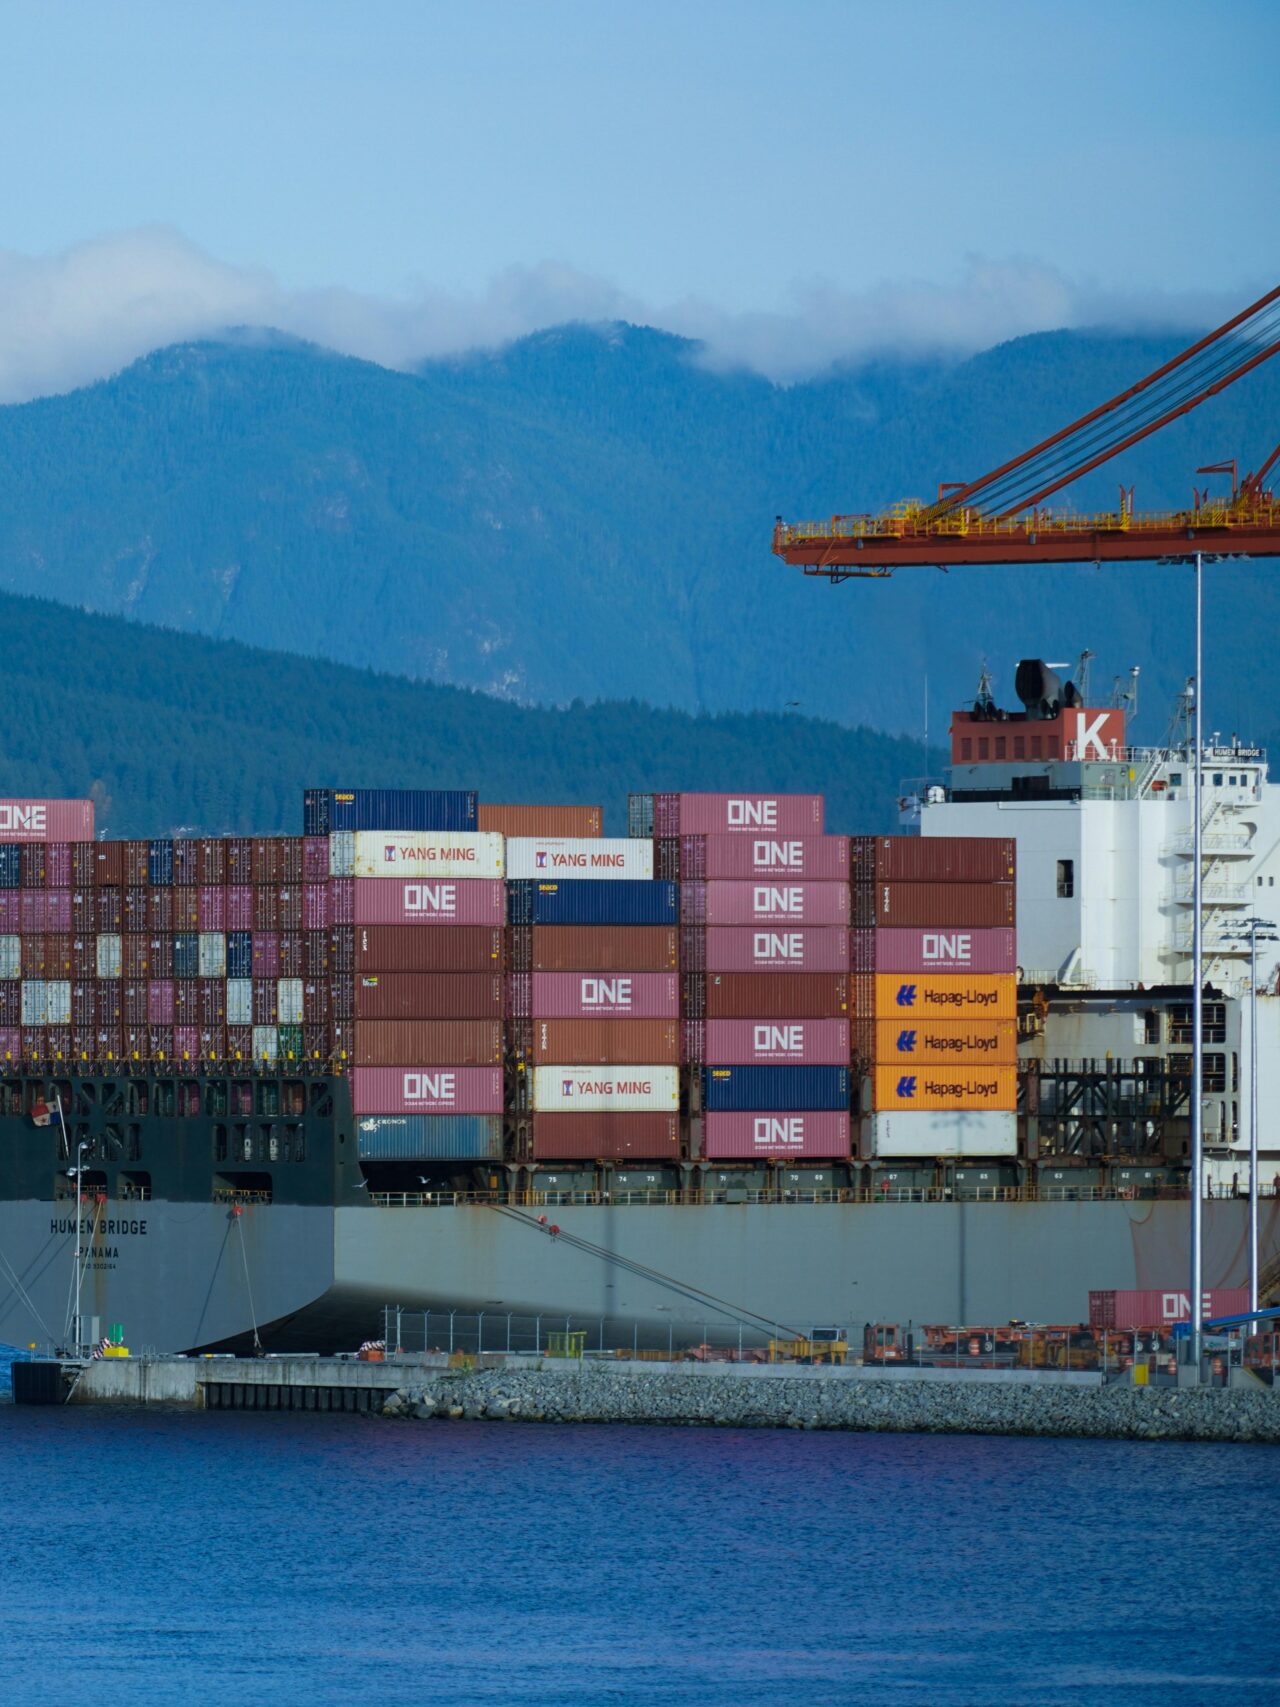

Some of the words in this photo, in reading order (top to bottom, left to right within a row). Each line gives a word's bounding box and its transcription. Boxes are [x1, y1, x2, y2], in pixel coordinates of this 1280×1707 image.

[1076, 712, 1111, 760] K
[1214, 748, 1236, 756] HUMEN
[1237, 748, 1260, 757] BRIDGE
[728, 800, 777, 825] ONE
[400, 847, 436, 861] YANG
[440, 847, 475, 861] MING
[551, 853, 587, 867] YANG
[591, 853, 625, 867] MING
[754, 841, 803, 866] ONE
[404, 885, 456, 910] ONE
[754, 887, 803, 912] ONE
[754, 933, 804, 958] ONE
[922, 934, 972, 959] ONE
[581, 978, 632, 1004] ONE
[924, 989, 998, 1007] Hapag-Lloyd
[754, 1025, 804, 1050] ONE
[924, 1035, 998, 1052] Hapag-Lloyd
[404, 1073, 455, 1099] ONE
[577, 1081, 613, 1095] YANG
[616, 1081, 651, 1095] MING
[924, 1081, 998, 1098] Hapag-Lloyd
[754, 1118, 804, 1143] ONE
[50, 1219, 94, 1234] HUMEN
[99, 1220, 148, 1235] BRIDGE
[78, 1246, 119, 1258] PANAMA
